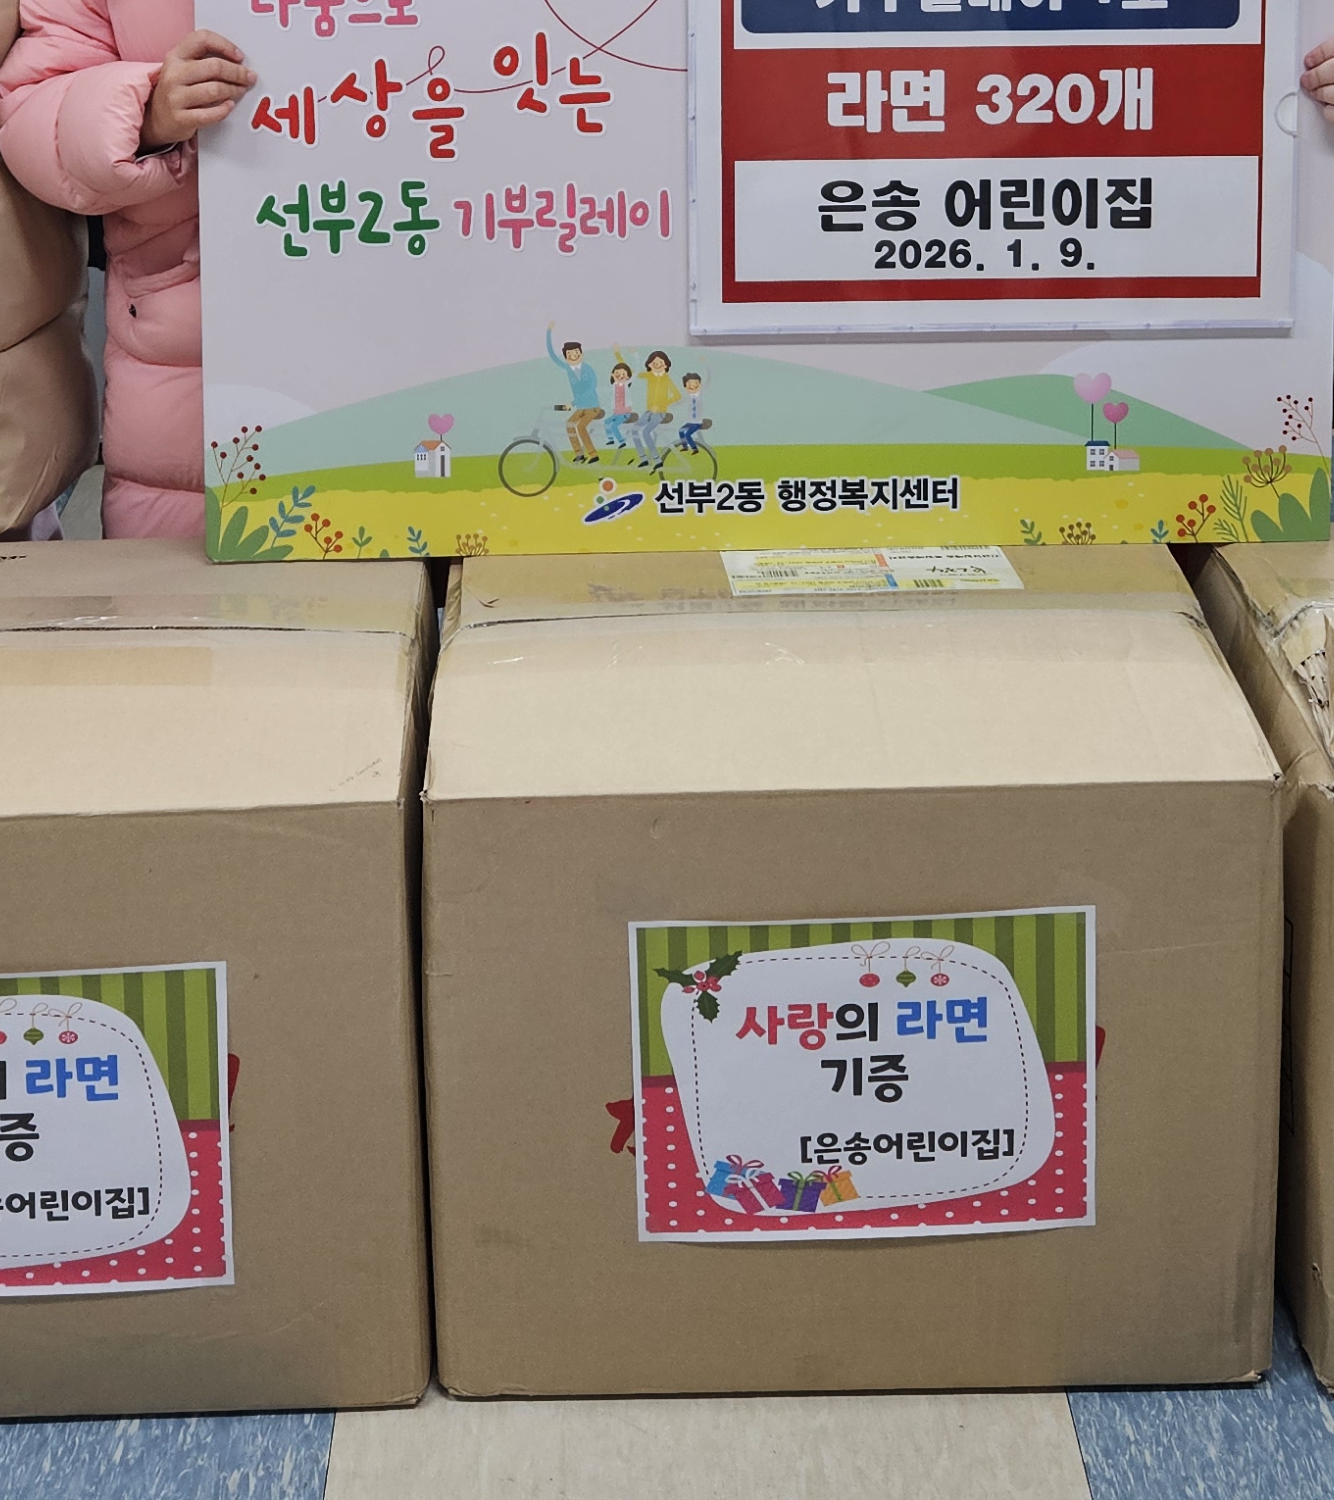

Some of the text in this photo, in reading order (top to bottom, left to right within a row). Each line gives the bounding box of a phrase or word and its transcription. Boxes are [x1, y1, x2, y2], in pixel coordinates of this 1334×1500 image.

[251, 32, 612, 159] 세상을 잇는
[827, 67, 1154, 133] 라면 320개
[256, 180, 671, 258] 선부2동 기부릴레이
[818, 176, 1154, 233] 은송 어린이집
[874, 238, 1096, 272] 2026. 1. 9.
[653, 475, 962, 517] 선부2동 행정복지센터
[735, 996, 989, 1050] 사랑의 라면
[25, 1054, 119, 1102] 라면
[820, 1053, 909, 1102] 기증
[800, 1129, 1015, 1165] [은송어린이집]
